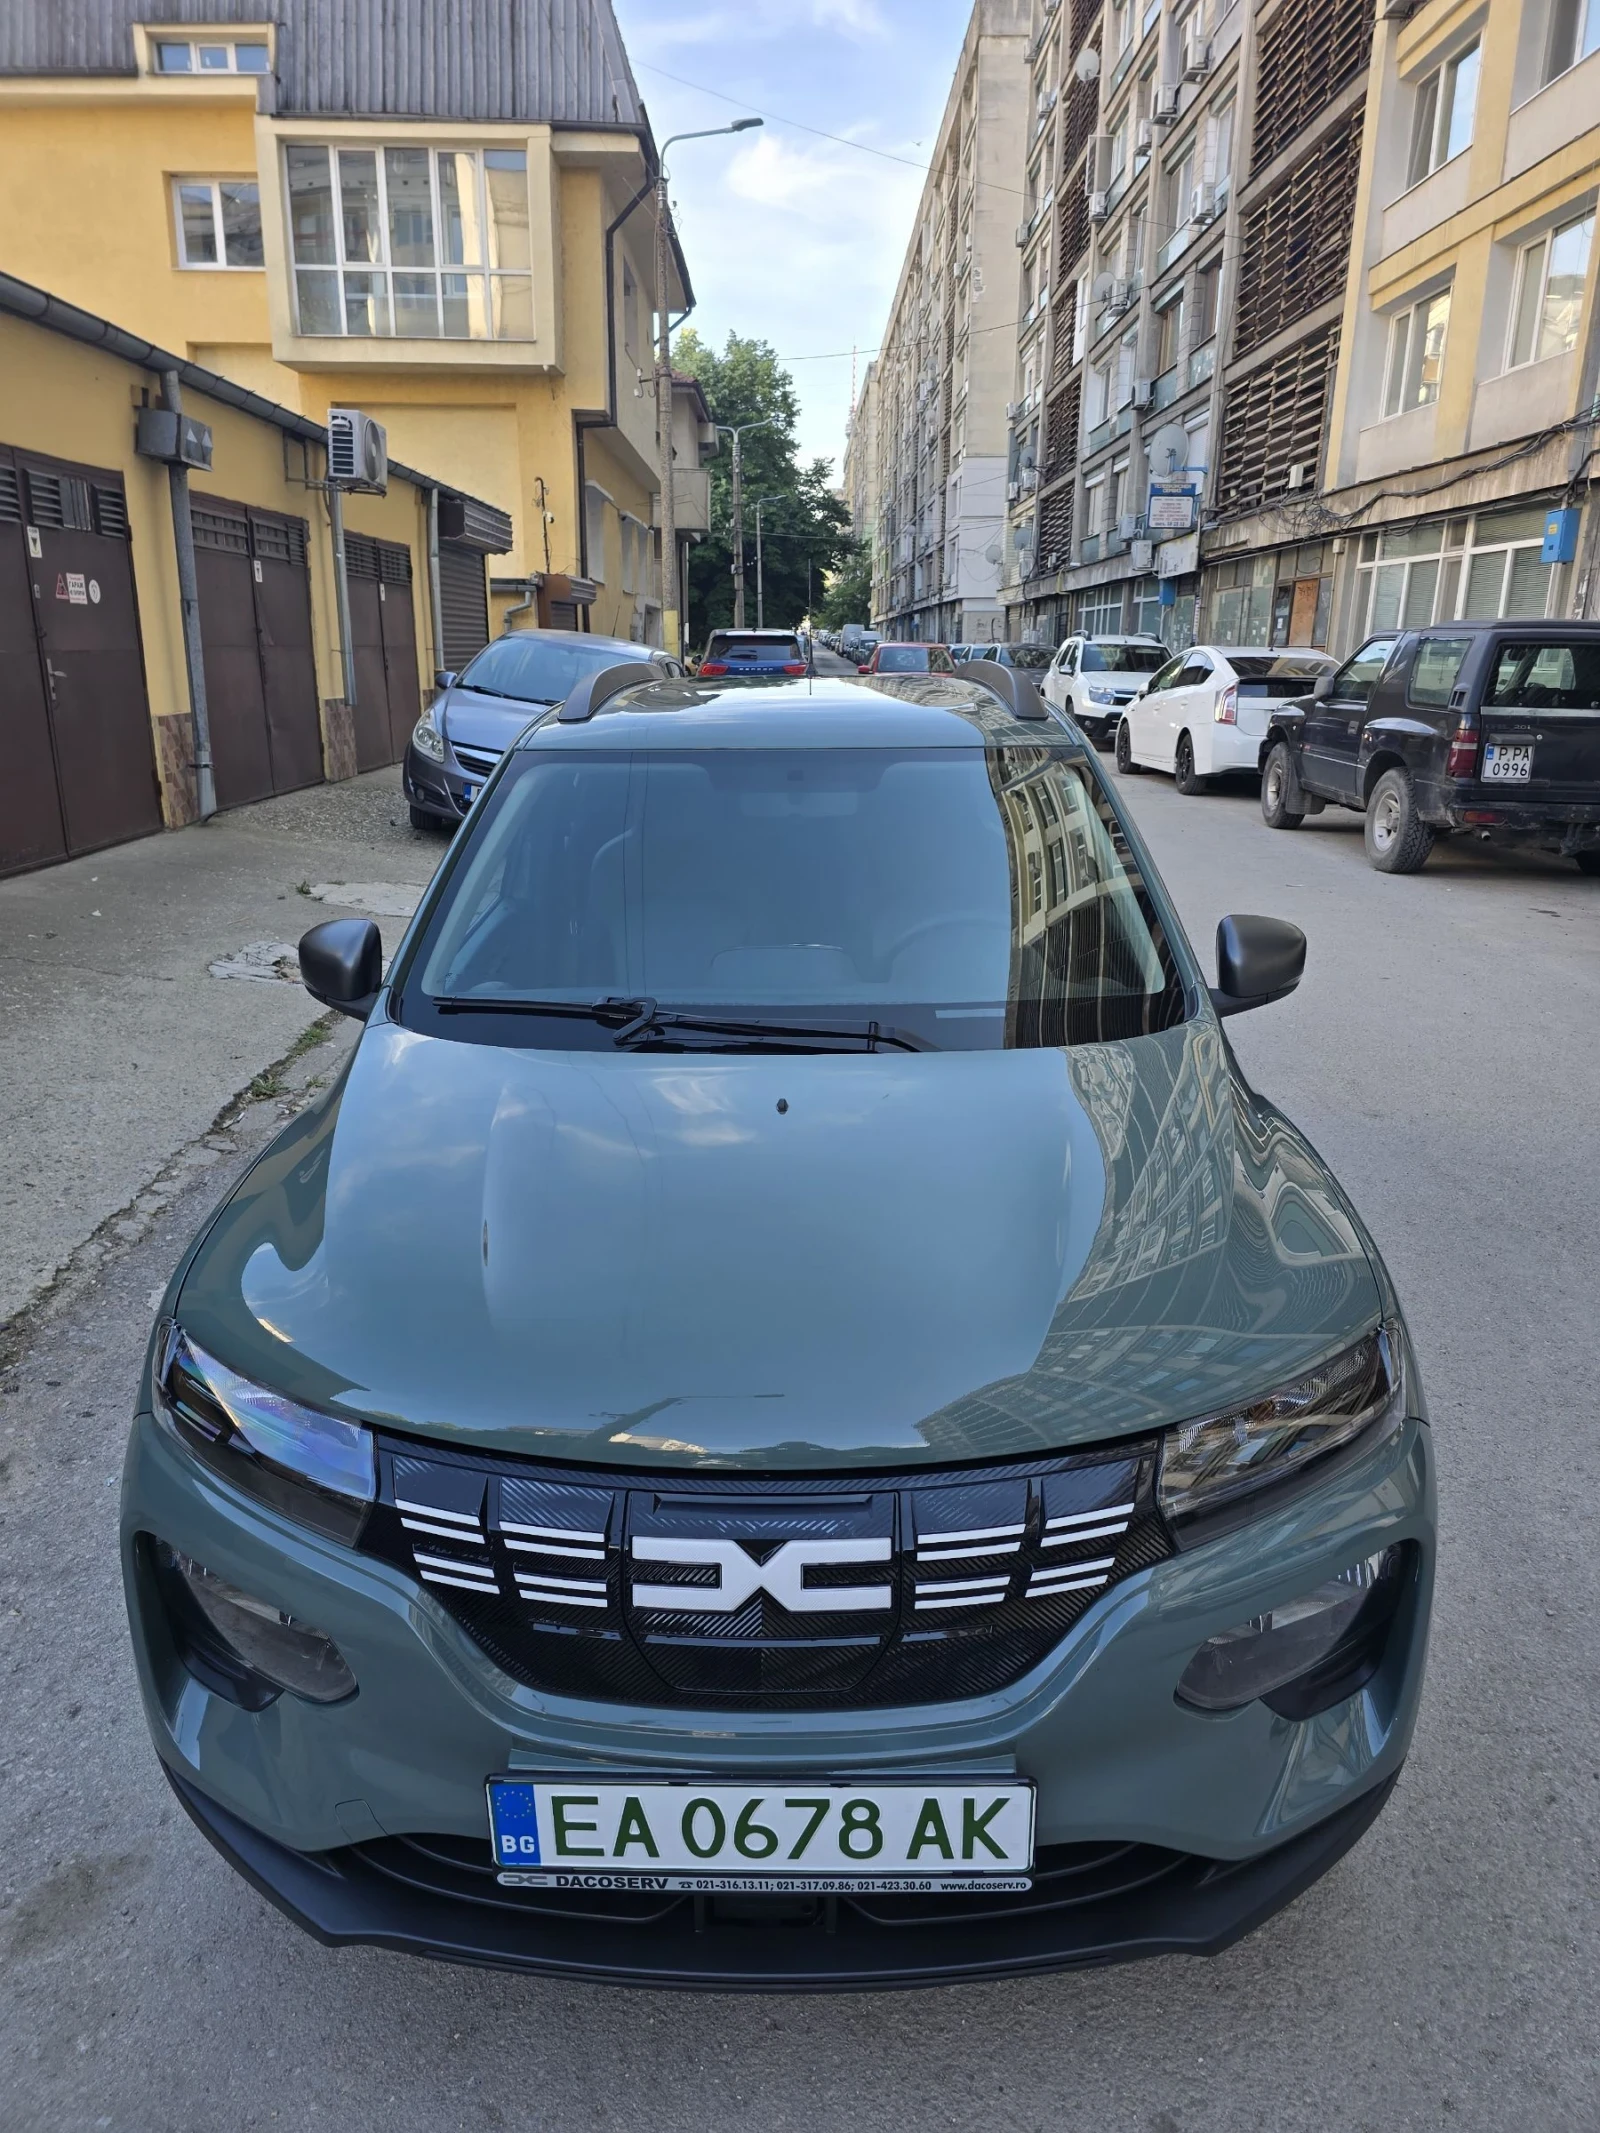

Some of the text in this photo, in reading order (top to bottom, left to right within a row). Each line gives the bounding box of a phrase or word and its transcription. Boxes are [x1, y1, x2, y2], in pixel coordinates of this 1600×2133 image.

[1513, 747, 1529, 761] PA
[1493, 763, 1527, 776] 0996
[551, 1795, 1011, 1860] EA 0678 AK
[501, 1834, 535, 1854] BG
[555, 1875, 1027, 1892] DACOSERV 021-316.13.11; 021-317.09.86; 021-423.30.60 www.dacoserv.ro
